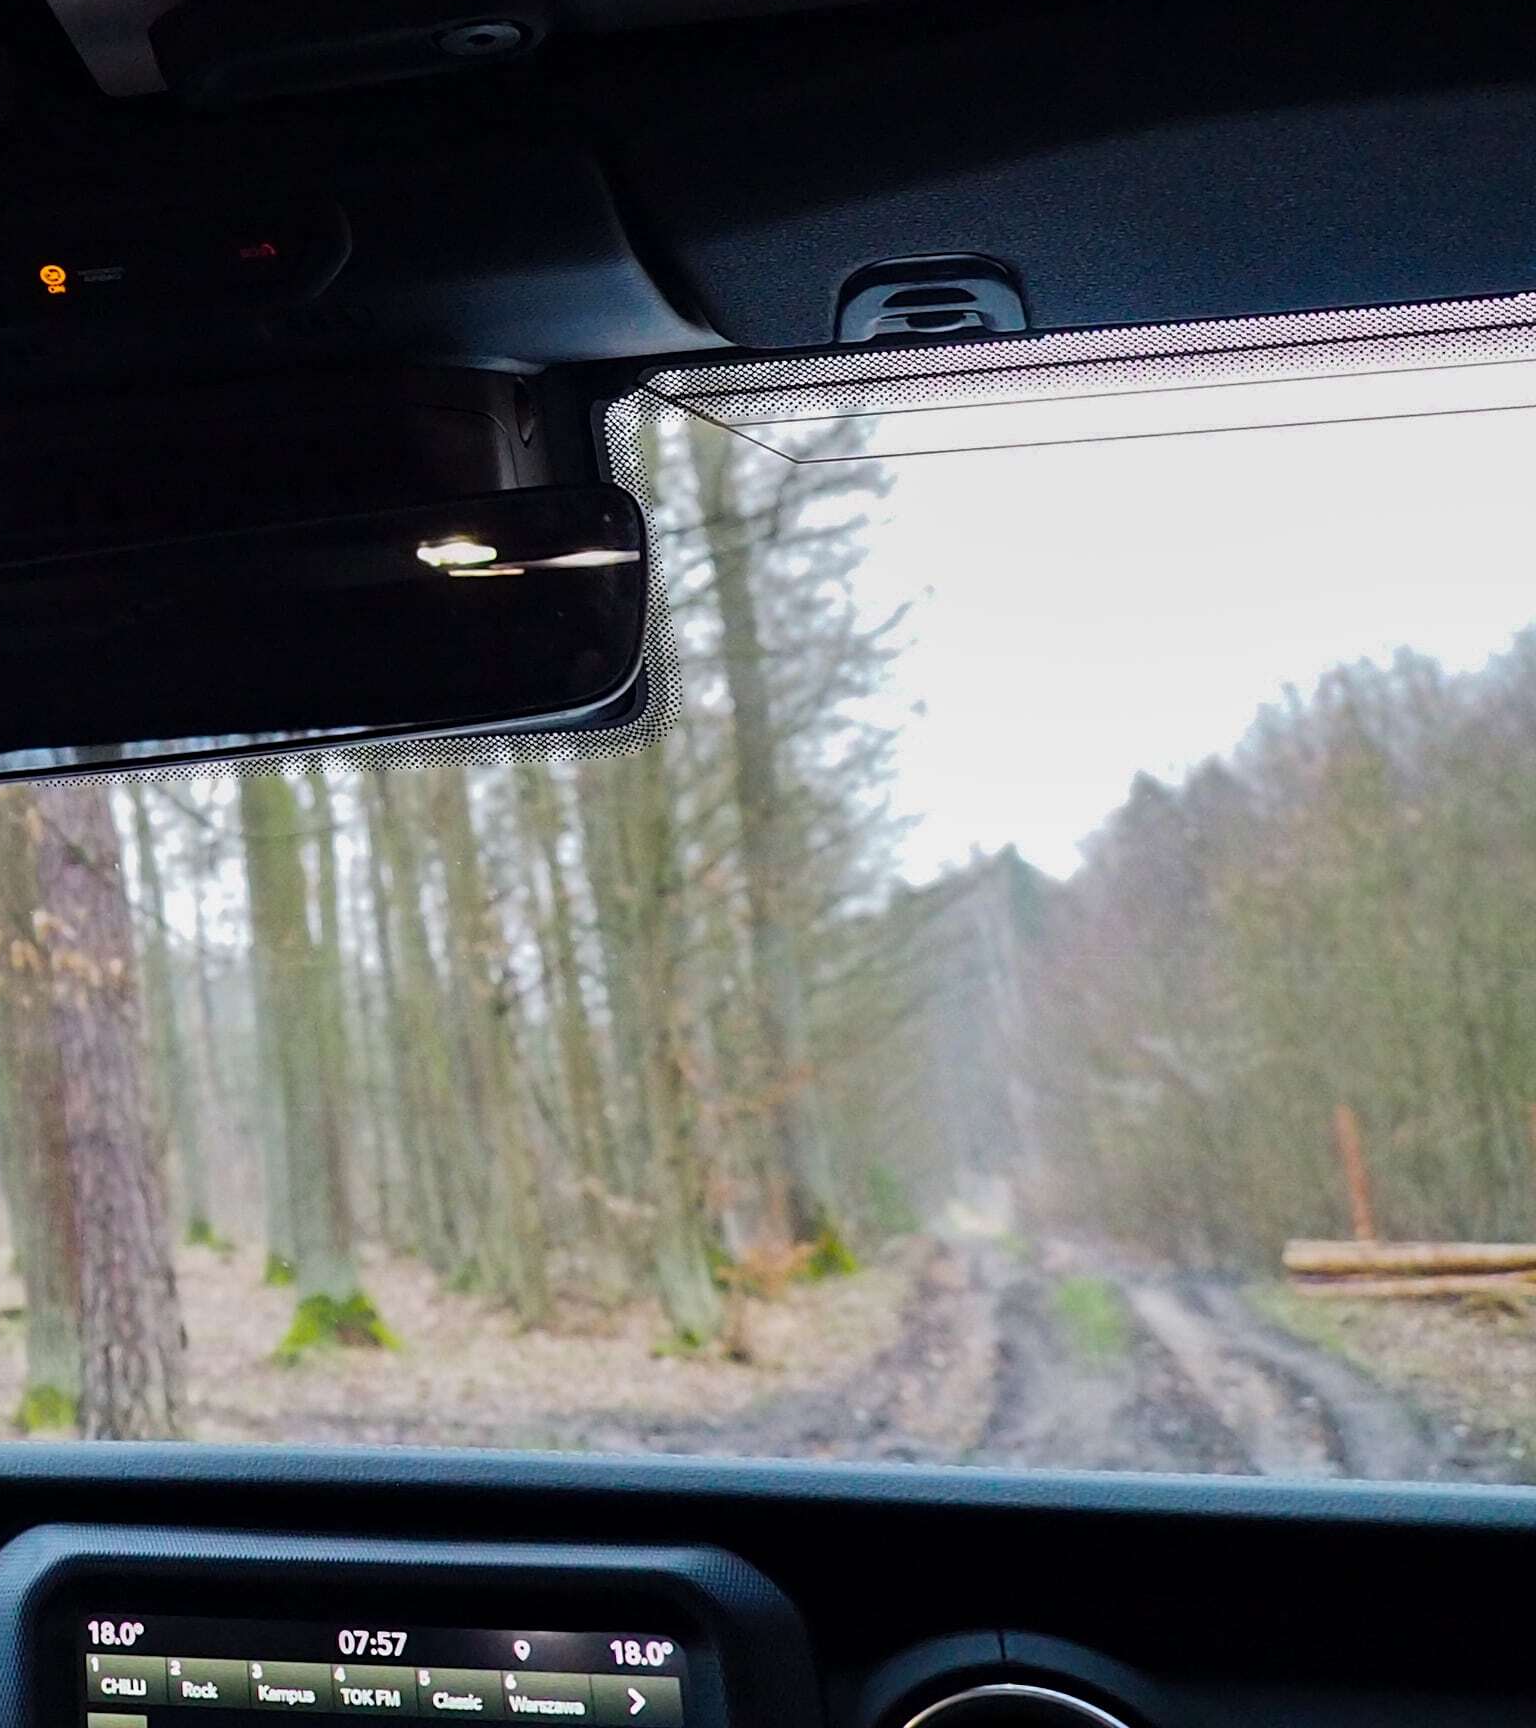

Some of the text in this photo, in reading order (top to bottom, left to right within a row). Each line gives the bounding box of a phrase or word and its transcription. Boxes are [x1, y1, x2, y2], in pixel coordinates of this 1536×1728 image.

[338, 1629, 408, 1657] 07:57
[90, 1656, 99, 1673] 1
[170, 1659, 182, 1676] 2
[251, 1663, 263, 1679] 3
[334, 1666, 346, 1682] 4
[419, 1670, 431, 1686] 5
[505, 1673, 517, 1690] 6
[182, 1680, 219, 1700] Rock
[258, 1684, 316, 1706] Kampus
[340, 1688, 401, 1708] TOK FM
[432, 1691, 484, 1711] Classic
